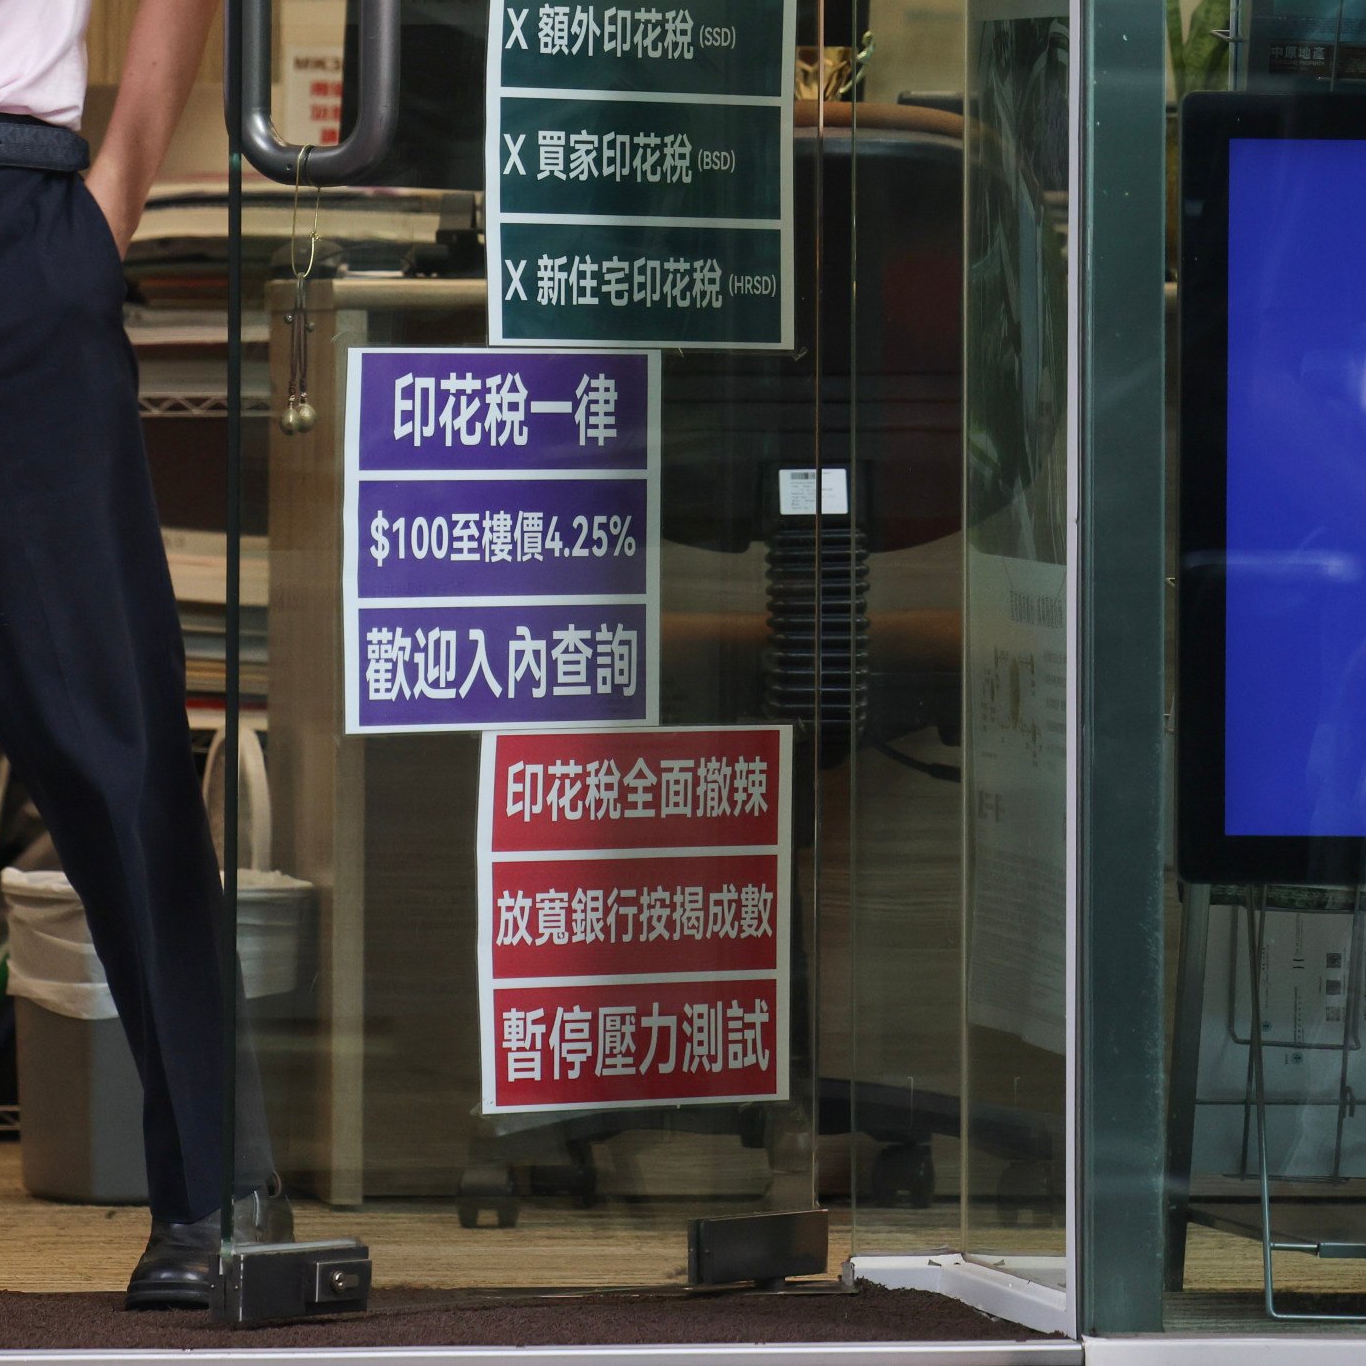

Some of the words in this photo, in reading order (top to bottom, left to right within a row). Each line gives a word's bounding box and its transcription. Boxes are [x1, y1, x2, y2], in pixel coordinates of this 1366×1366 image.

[537, 2, 695, 60] 額外印花稅
[699, 25, 736, 50] (SSD)
[536, 129, 693, 184] 買家印花稅
[697, 148, 736, 174] (BSD)
[536, 253, 723, 309] 新住宅印花稅
[728, 272, 777, 298] (HRSD)
[393, 371, 619, 448] 印花稅一律
[369, 509, 637, 568] $100至樓價4.25%
[365, 622, 639, 703] 歡迎入內查詢
[504, 755, 769, 823] 印花稅全面撤辣
[495, 882, 774, 947] 放寬銀行按揭成數
[501, 997, 771, 1083] 暫停壓力測試
